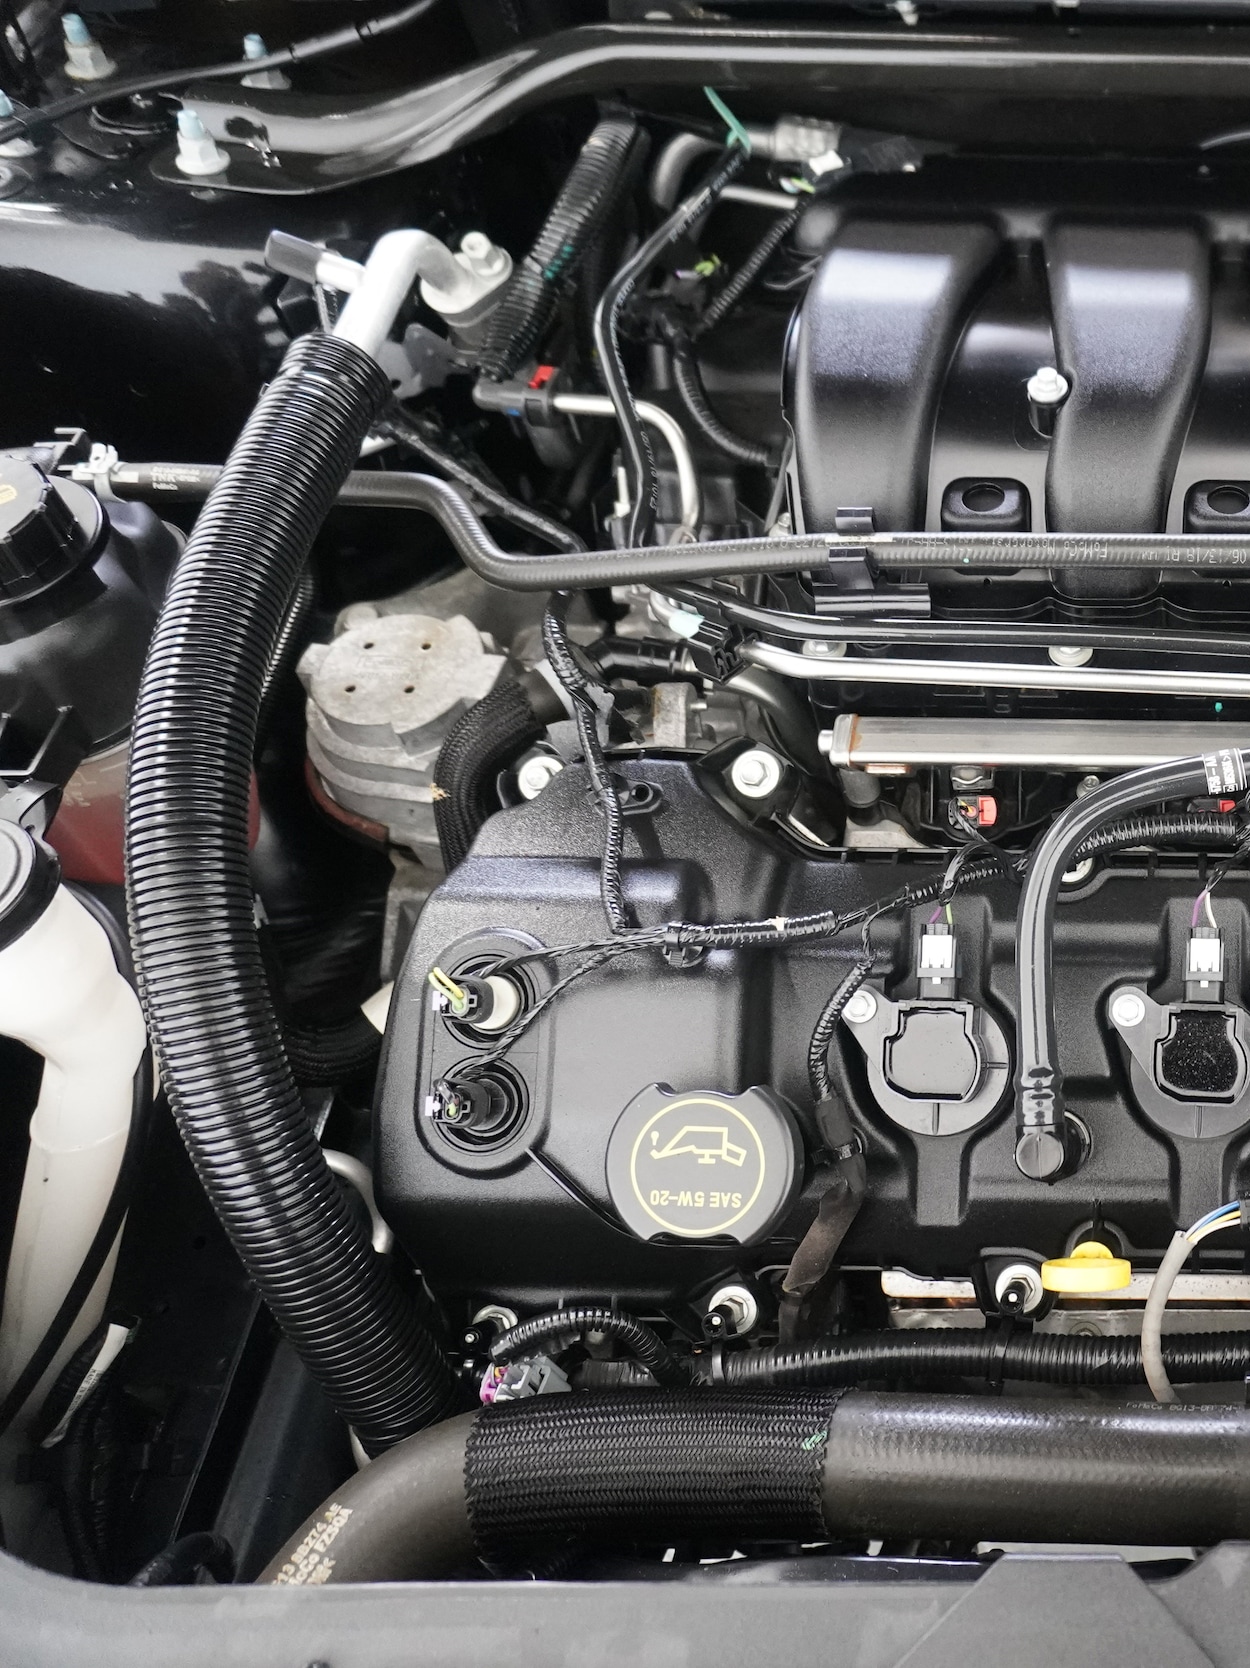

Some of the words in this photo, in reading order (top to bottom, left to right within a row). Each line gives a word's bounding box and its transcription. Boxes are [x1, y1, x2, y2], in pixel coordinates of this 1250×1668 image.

[981, 537, 1055, 555] Motorcraf
[1064, 541, 1108, 558] FoMoCo
[1187, 547, 1247, 564] 06/13/18
[650, 1190, 705, 1207] 5W-20
[710, 1192, 742, 1208] SAE
